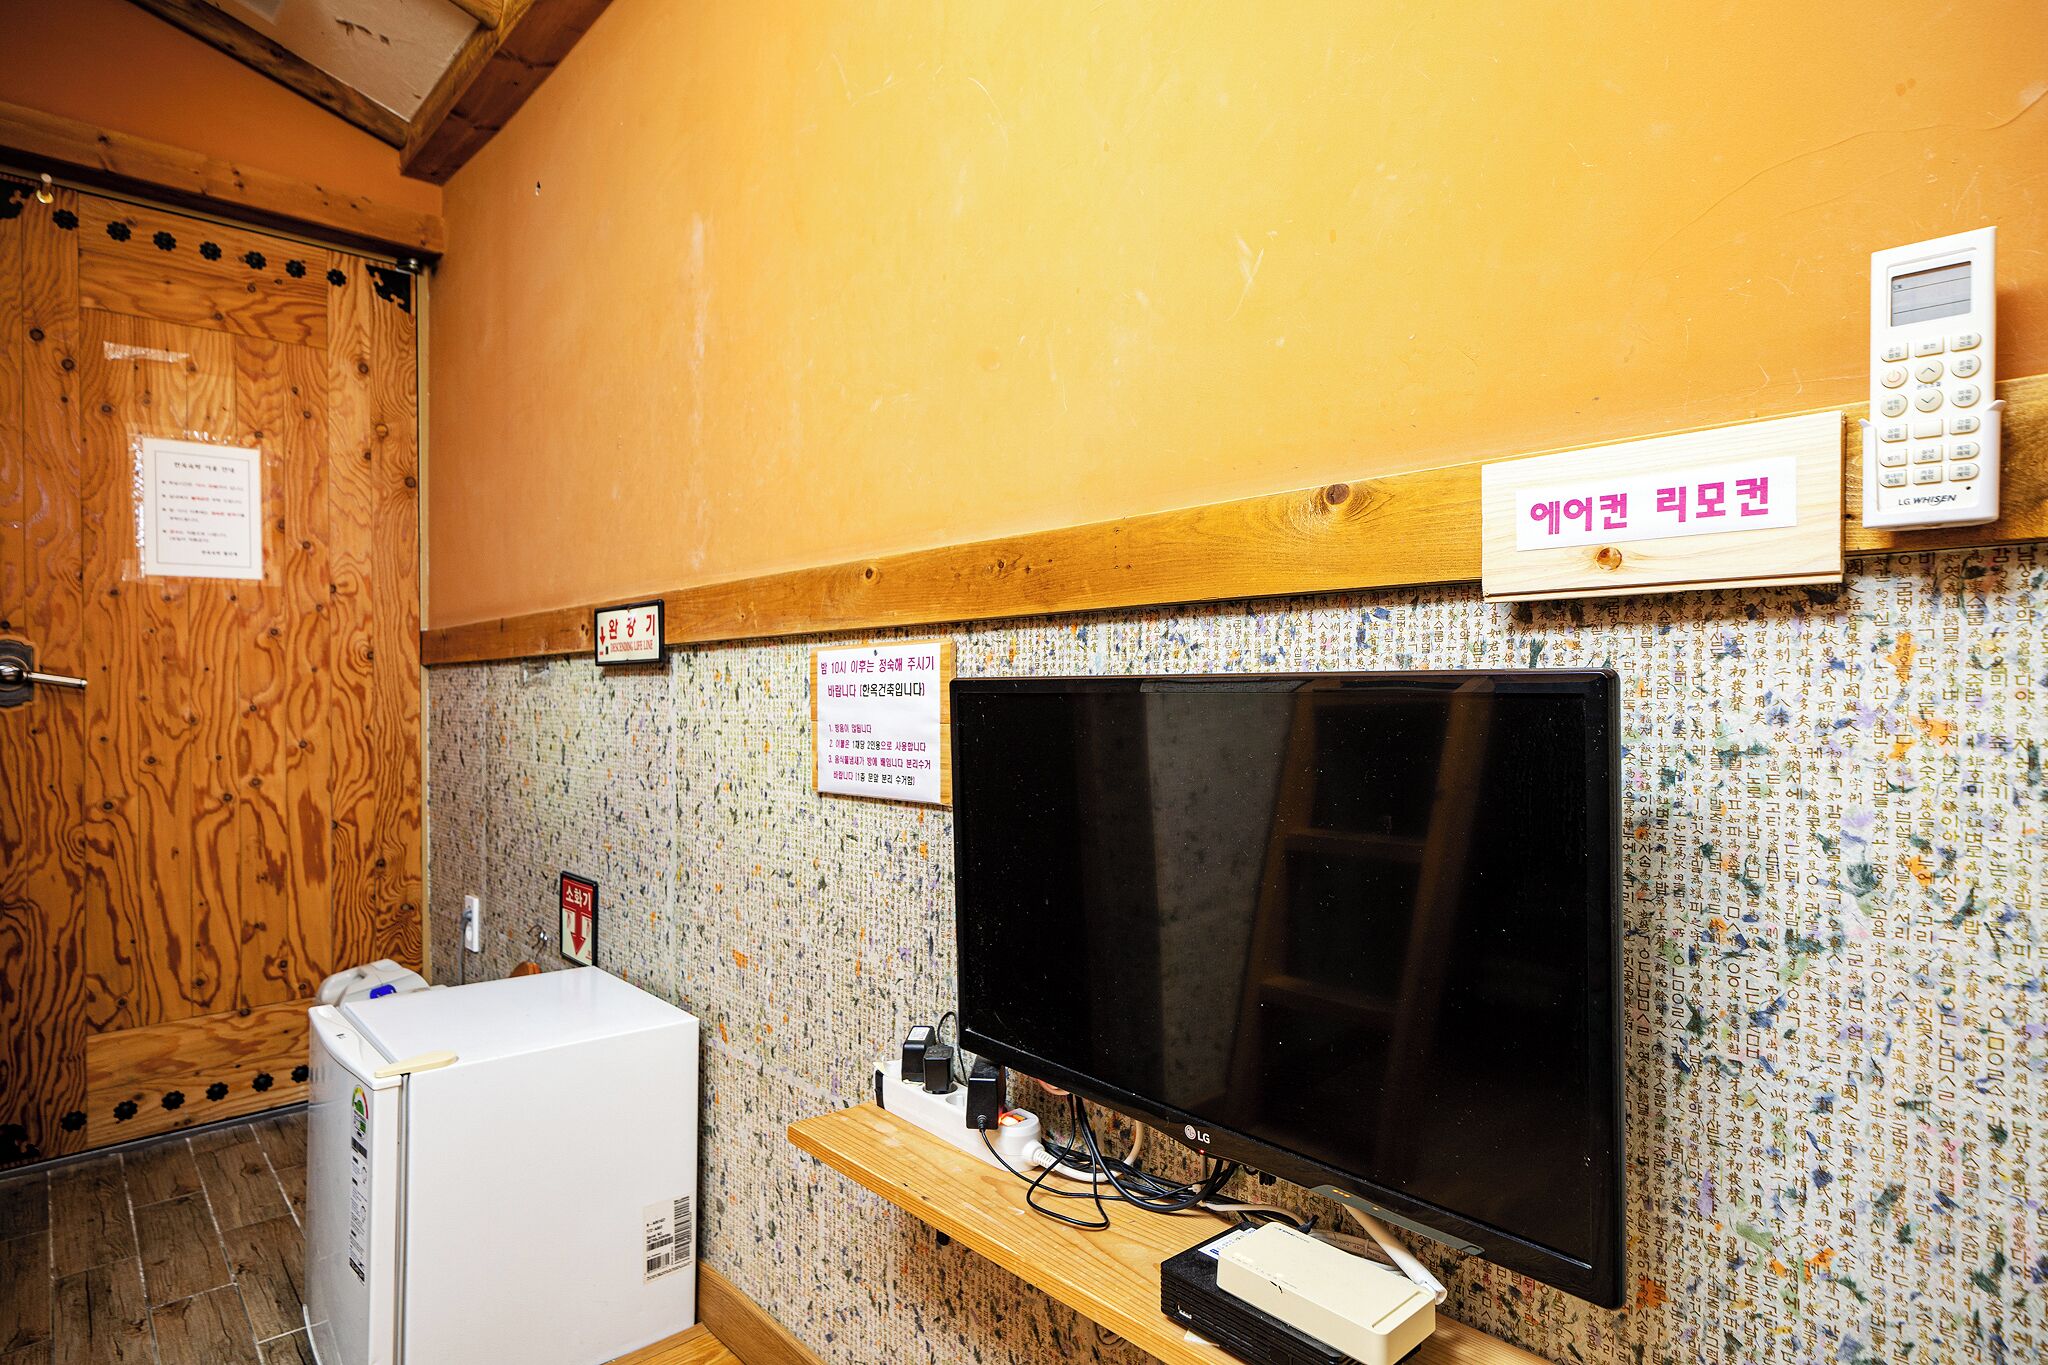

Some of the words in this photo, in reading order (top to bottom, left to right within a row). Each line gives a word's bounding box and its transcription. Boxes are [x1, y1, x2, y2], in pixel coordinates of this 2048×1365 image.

[1530, 492, 1628, 535] 에어컨
[1656, 476, 1769, 523] 리모컨
[1898, 498, 1911, 506] LG
[1913, 494, 1957, 506] WHISEN
[820, 662, 828, 675] 밤
[831, 660, 847, 674] 10시
[850, 659, 874, 674] 이후는
[907, 655, 934, 672] 주시기
[827, 684, 856, 698] 바랍니다
[894, 741, 926, 752] 사용합니다
[905, 758, 931, 770] 분리수거
[881, 774, 893, 784] 분리
[565, 885, 592, 912] 소화기
[1197, 1130, 1210, 1144] LG
